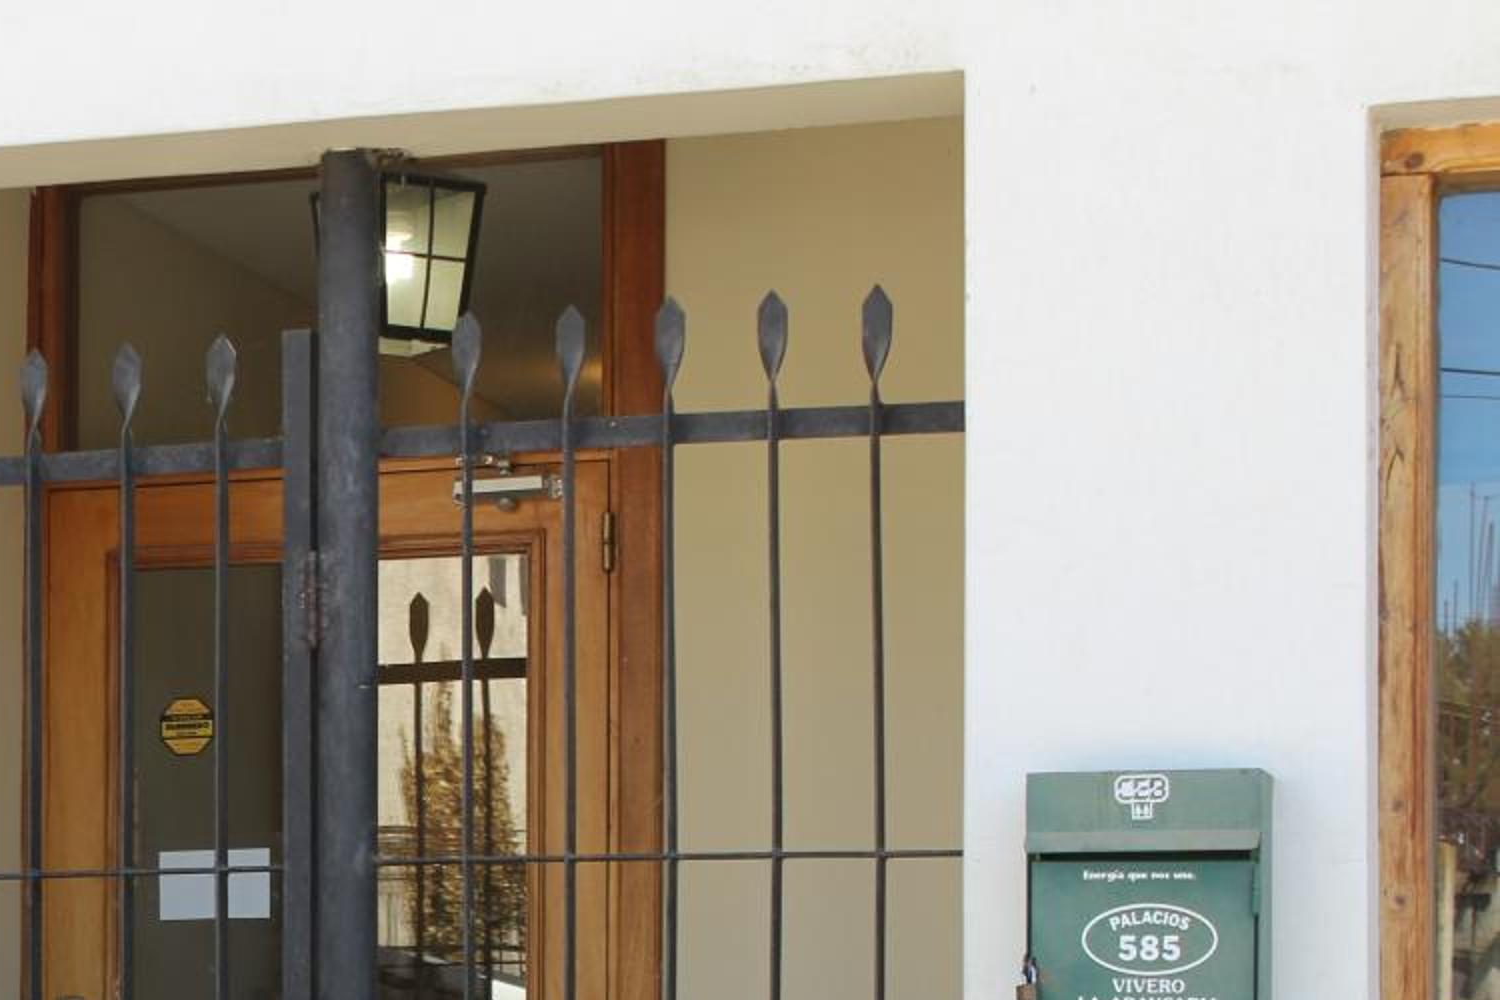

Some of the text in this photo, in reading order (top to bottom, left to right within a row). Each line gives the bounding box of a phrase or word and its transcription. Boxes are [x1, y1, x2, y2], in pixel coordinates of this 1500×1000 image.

[1109, 911, 1190, 931] PALACIOS
[1118, 934, 1181, 961] 585
[1112, 978, 1186, 993] VIVERO
